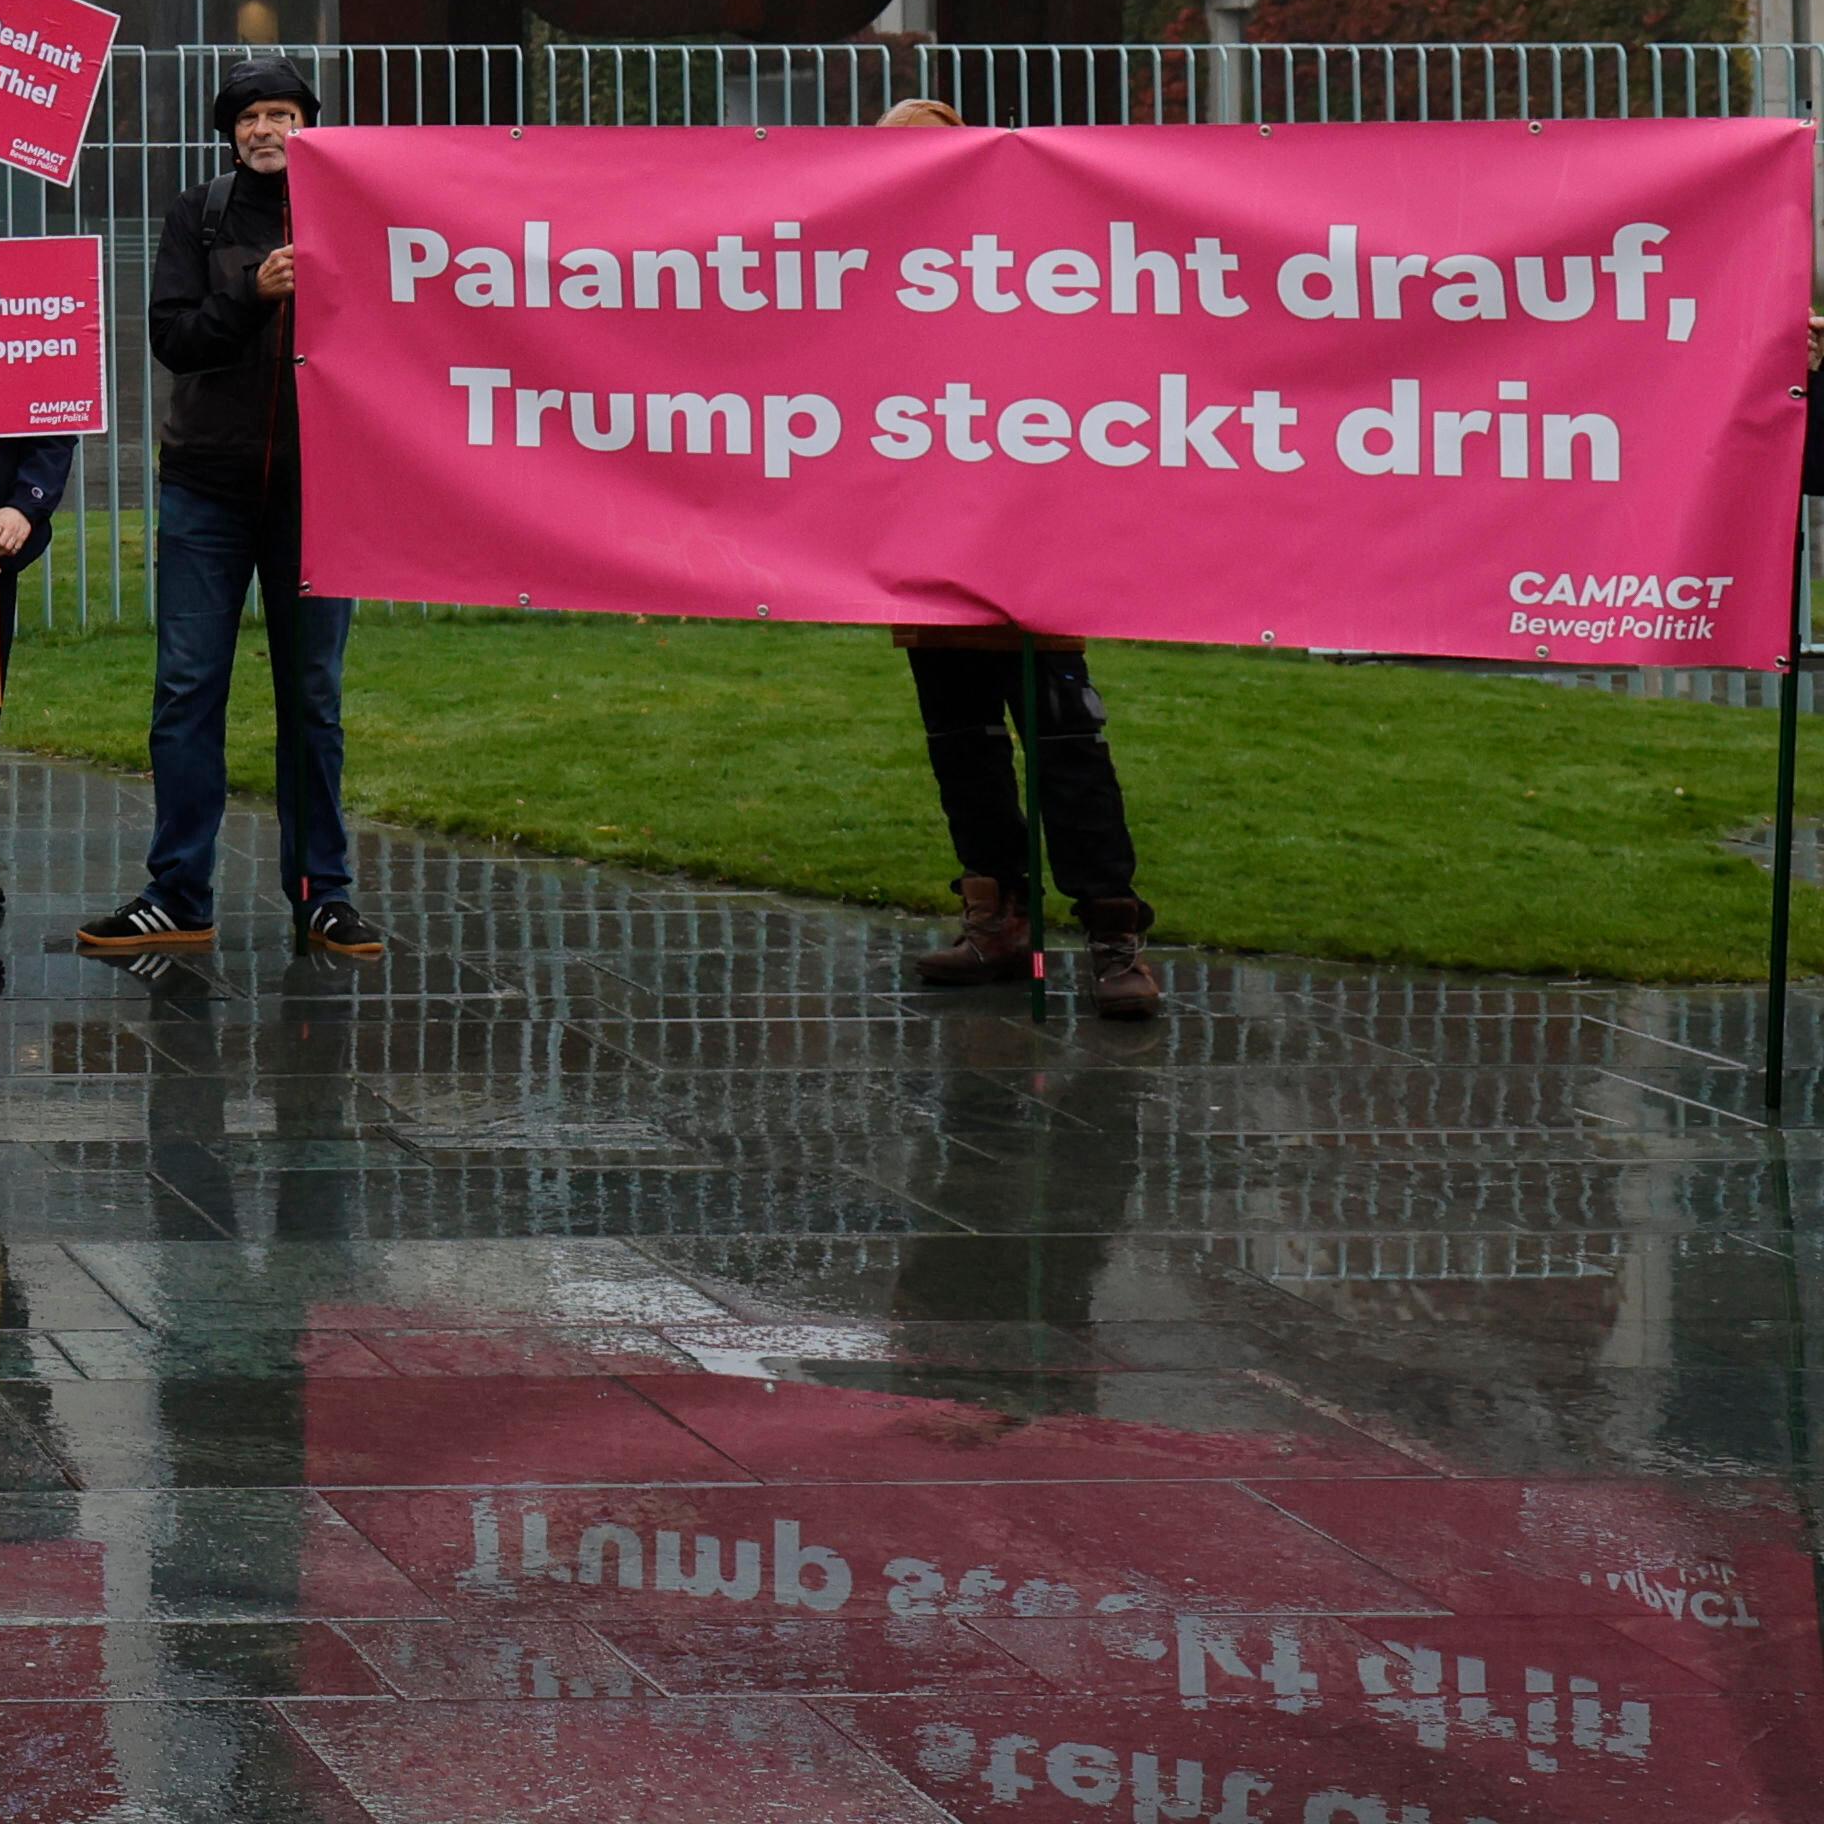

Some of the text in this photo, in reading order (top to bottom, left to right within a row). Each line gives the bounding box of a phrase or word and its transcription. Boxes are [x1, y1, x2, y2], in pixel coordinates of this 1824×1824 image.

[39, 41, 81, 73] mit
[12, 138, 66, 165] CAMPACT
[388, 221, 1695, 341] Palantir steht drauf,
[29, 400, 93, 414] CAMPACT
[30, 413, 89, 425] Bewegt Politik
[450, 367, 1619, 481] Trump steckt drin
[1510, 572, 1732, 609] CAMPACT
[1510, 612, 1713, 643] Bewegt Politik
